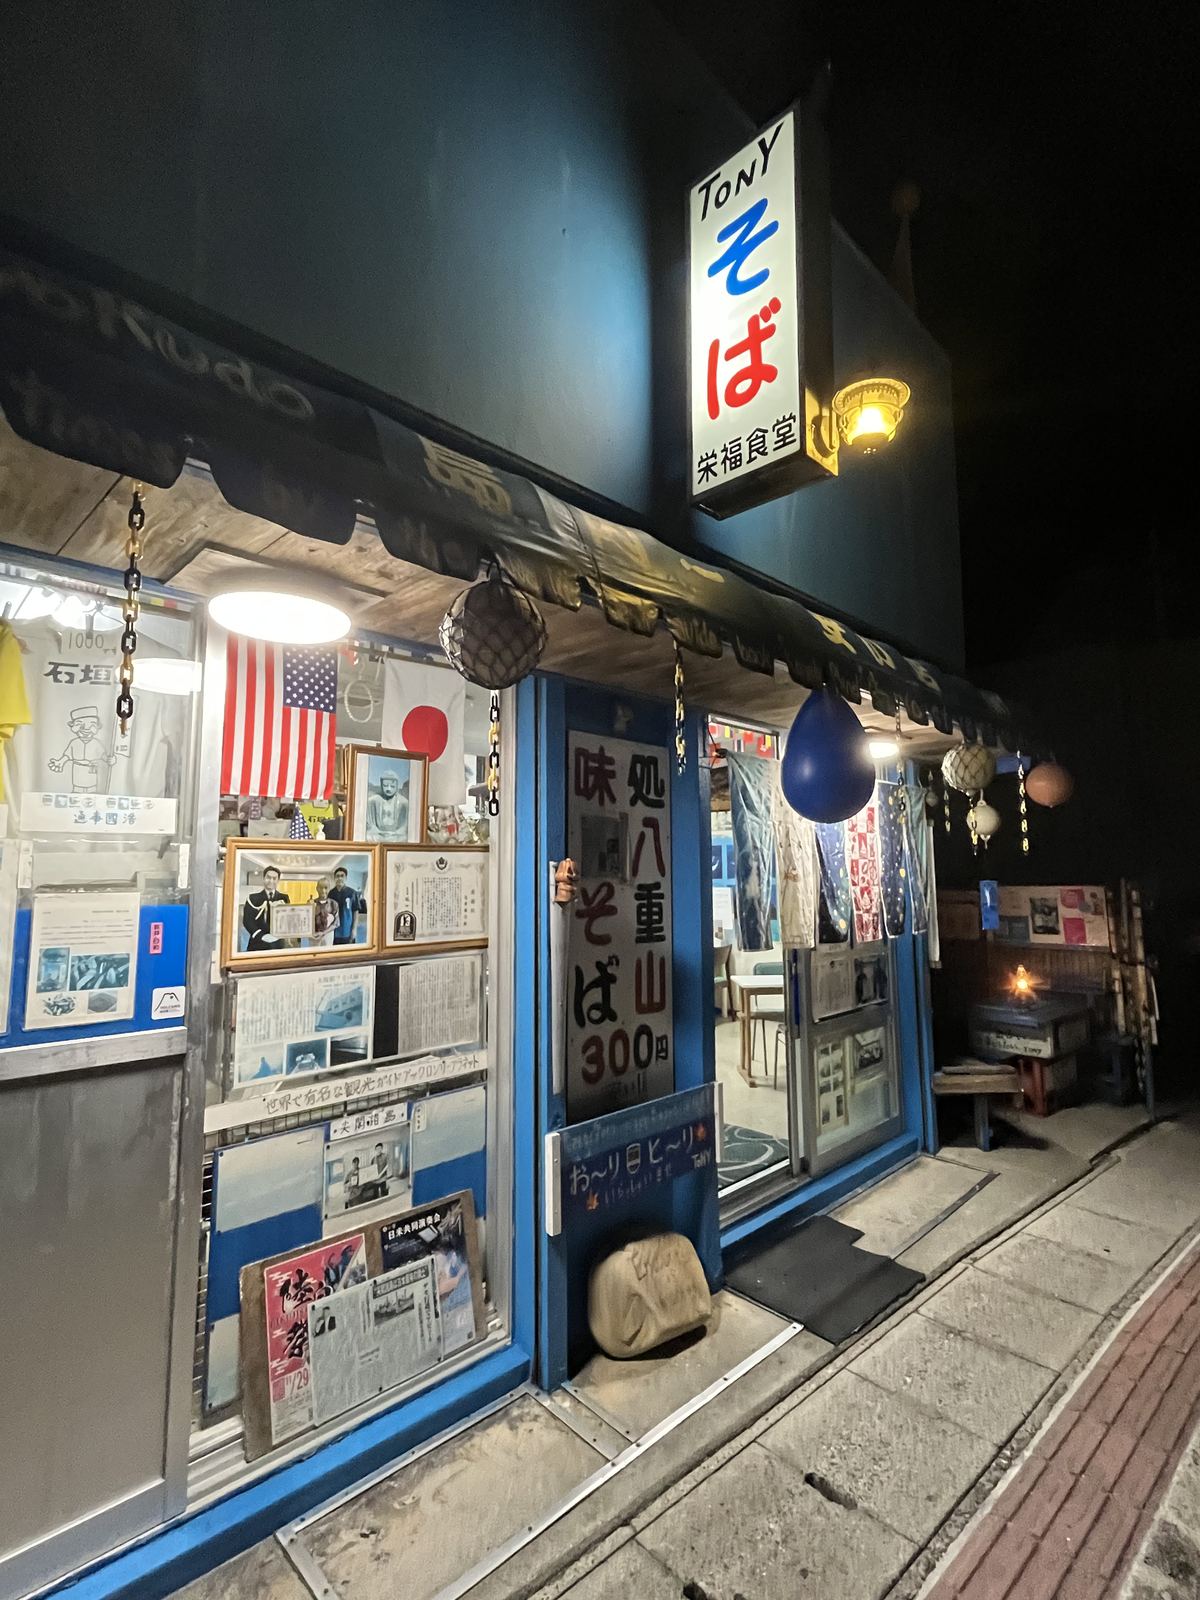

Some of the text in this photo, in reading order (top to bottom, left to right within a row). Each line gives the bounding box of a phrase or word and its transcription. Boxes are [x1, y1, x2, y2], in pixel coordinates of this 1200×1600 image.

[698, 122, 784, 221] TONY
[707, 198, 782, 420] そば
[697, 412, 797, 485] 栄福食堂
[575, 746, 666, 809] 味処
[574, 881, 620, 1028] そば
[631, 816, 666, 1015] 八重山
[581, 1023, 669, 1085] 300円
